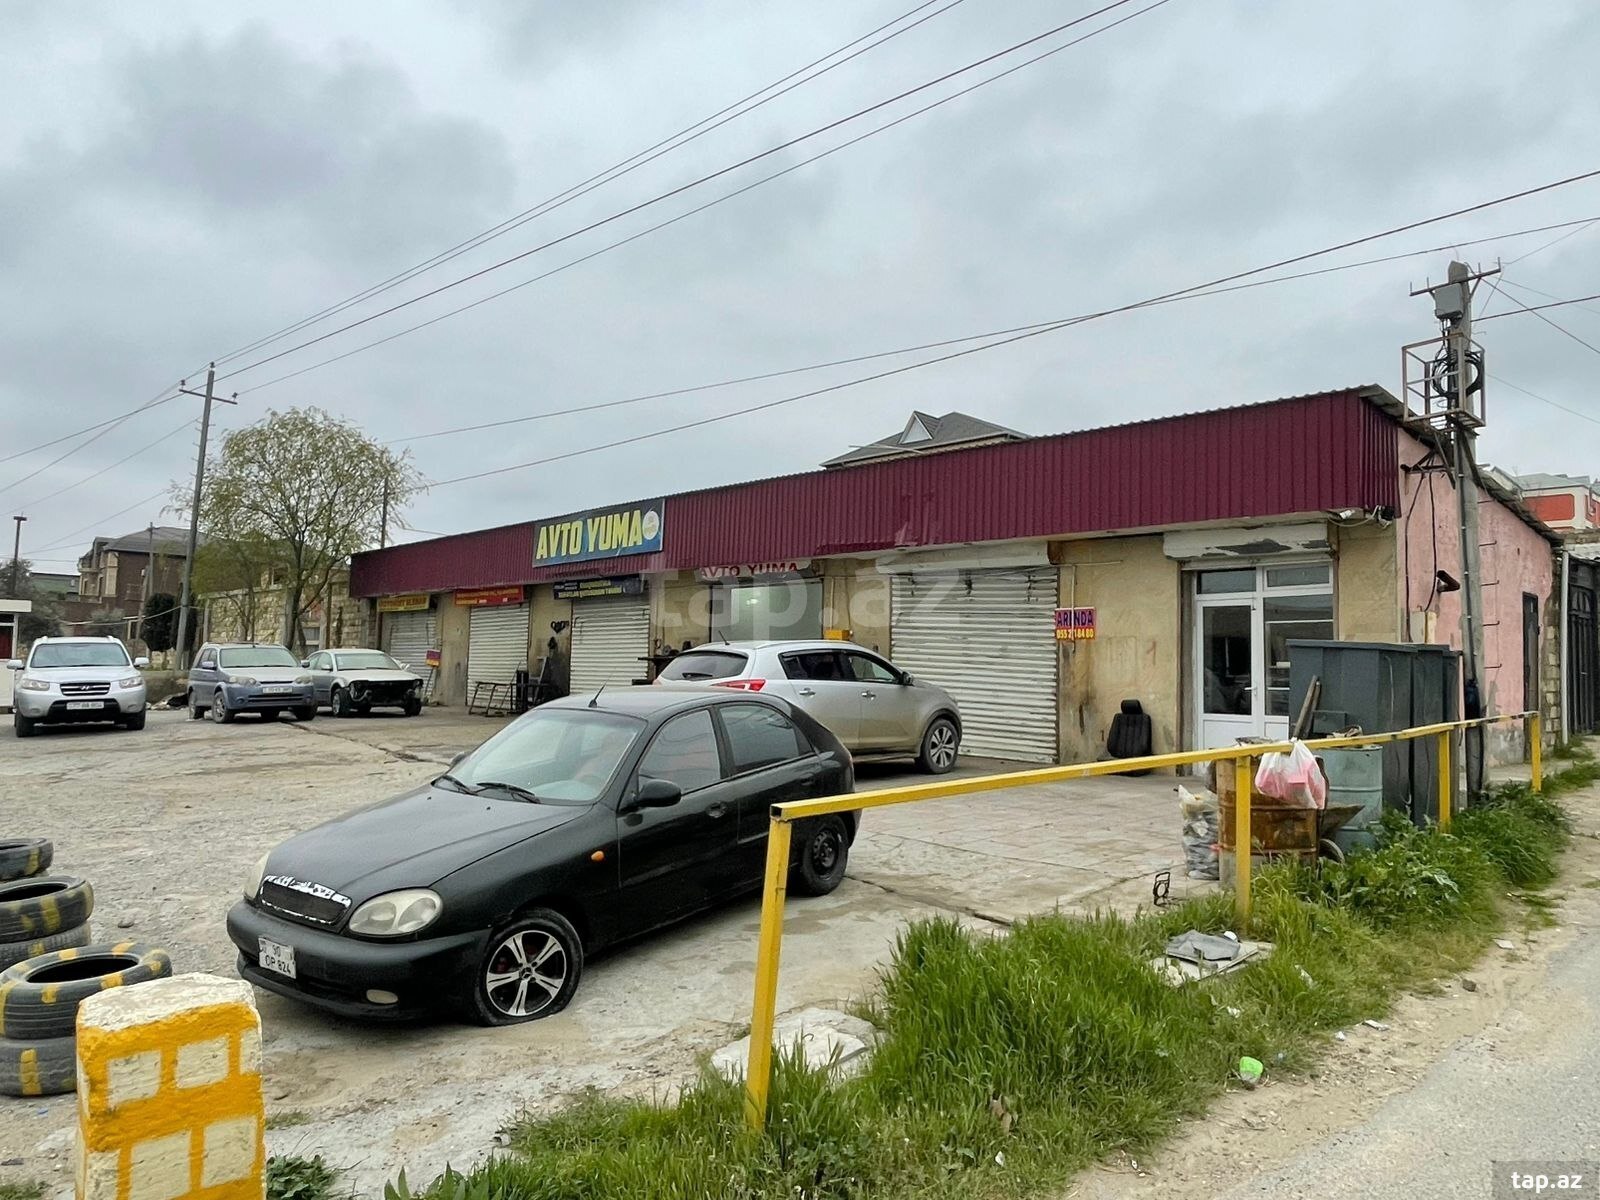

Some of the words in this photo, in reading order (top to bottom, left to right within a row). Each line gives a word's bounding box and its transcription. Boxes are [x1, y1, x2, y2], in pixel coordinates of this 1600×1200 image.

[535, 520, 583, 560] AVTO
[586, 509, 643, 553] YUMA
[700, 565, 740, 580] AVTO
[748, 562, 798, 578] YUMA
